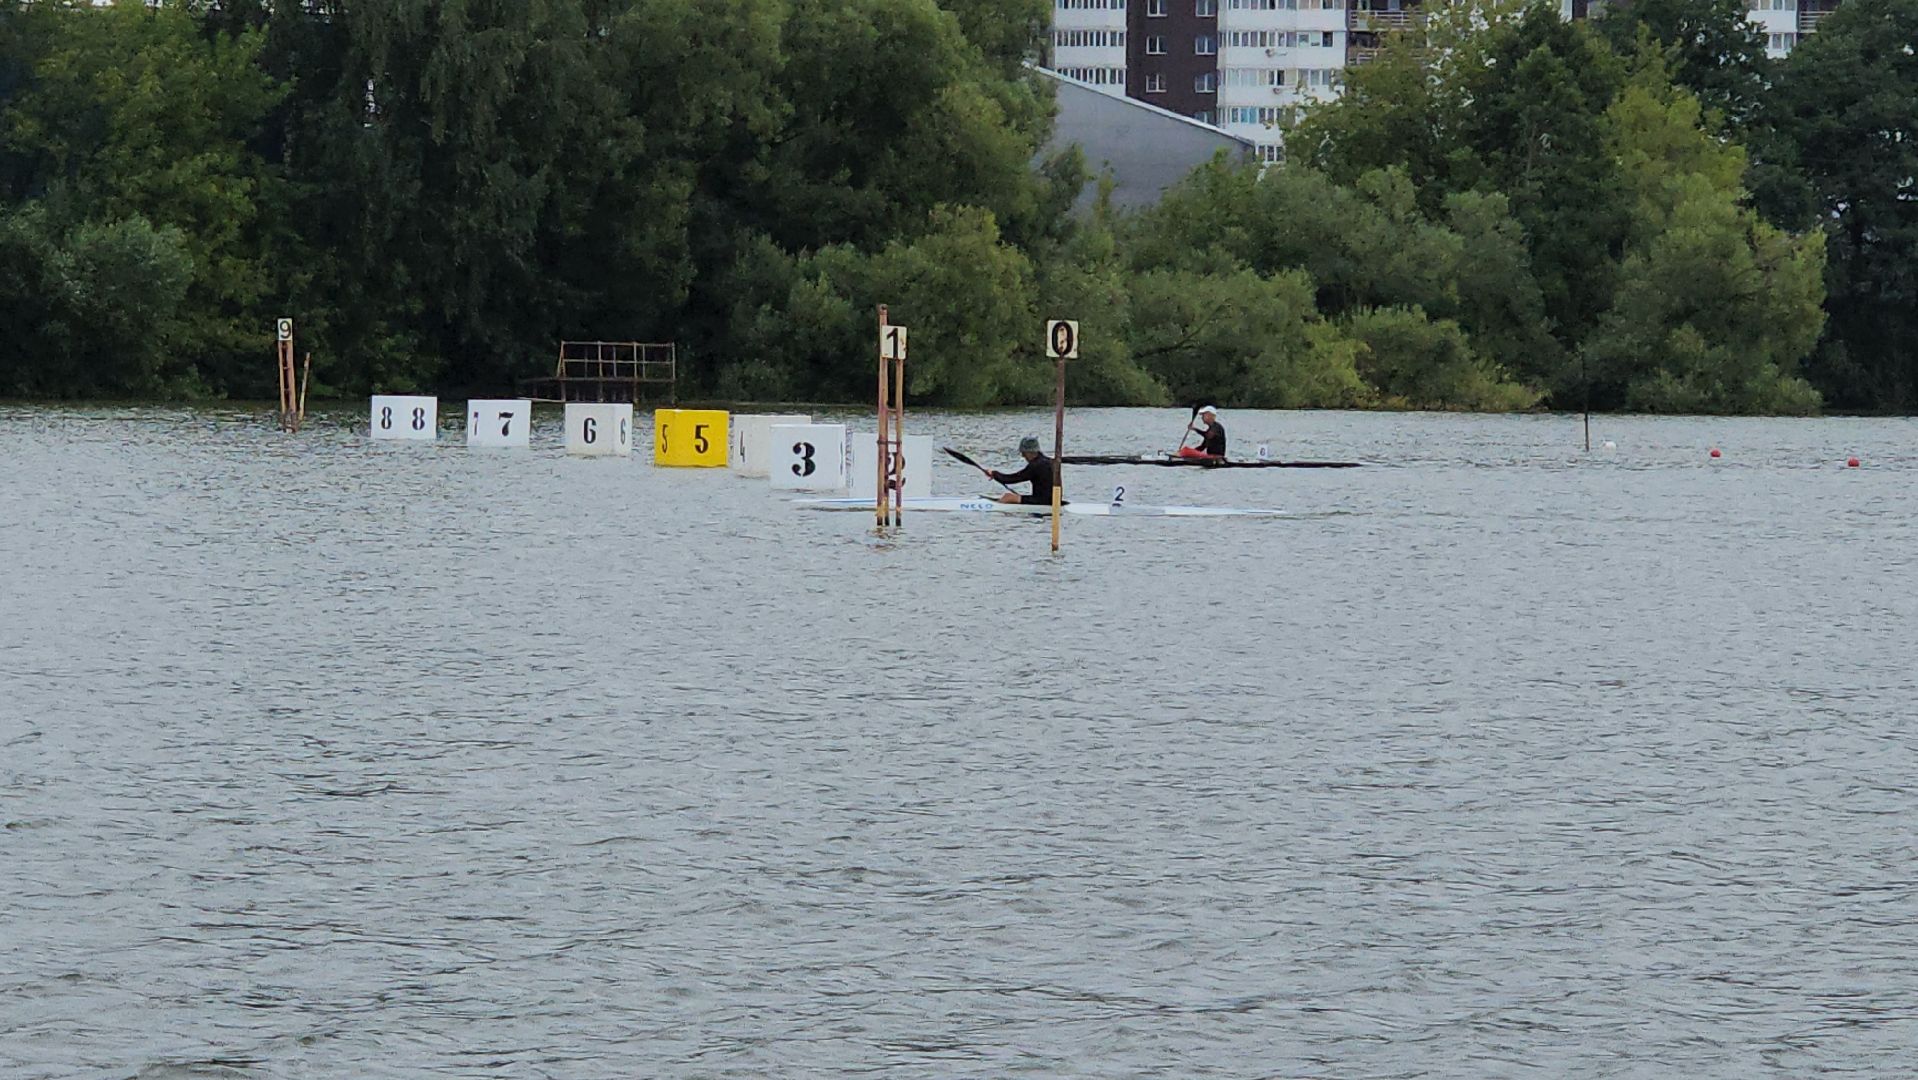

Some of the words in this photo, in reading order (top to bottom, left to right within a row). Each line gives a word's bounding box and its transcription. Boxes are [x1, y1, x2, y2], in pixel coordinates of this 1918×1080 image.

[279, 320, 292, 339] 9
[1051, 321, 1074, 356] 0
[886, 328, 899, 359] 1
[381, 406, 392, 430] 8
[412, 407, 425, 430] 8
[499, 412, 514, 437] 7
[583, 417, 597, 444] 6
[620, 417, 626, 445] 6
[662, 424, 668, 454] 5
[694, 424, 709, 454] 5
[791, 441, 816, 477] 3
[1114, 486, 1125, 502] 2
